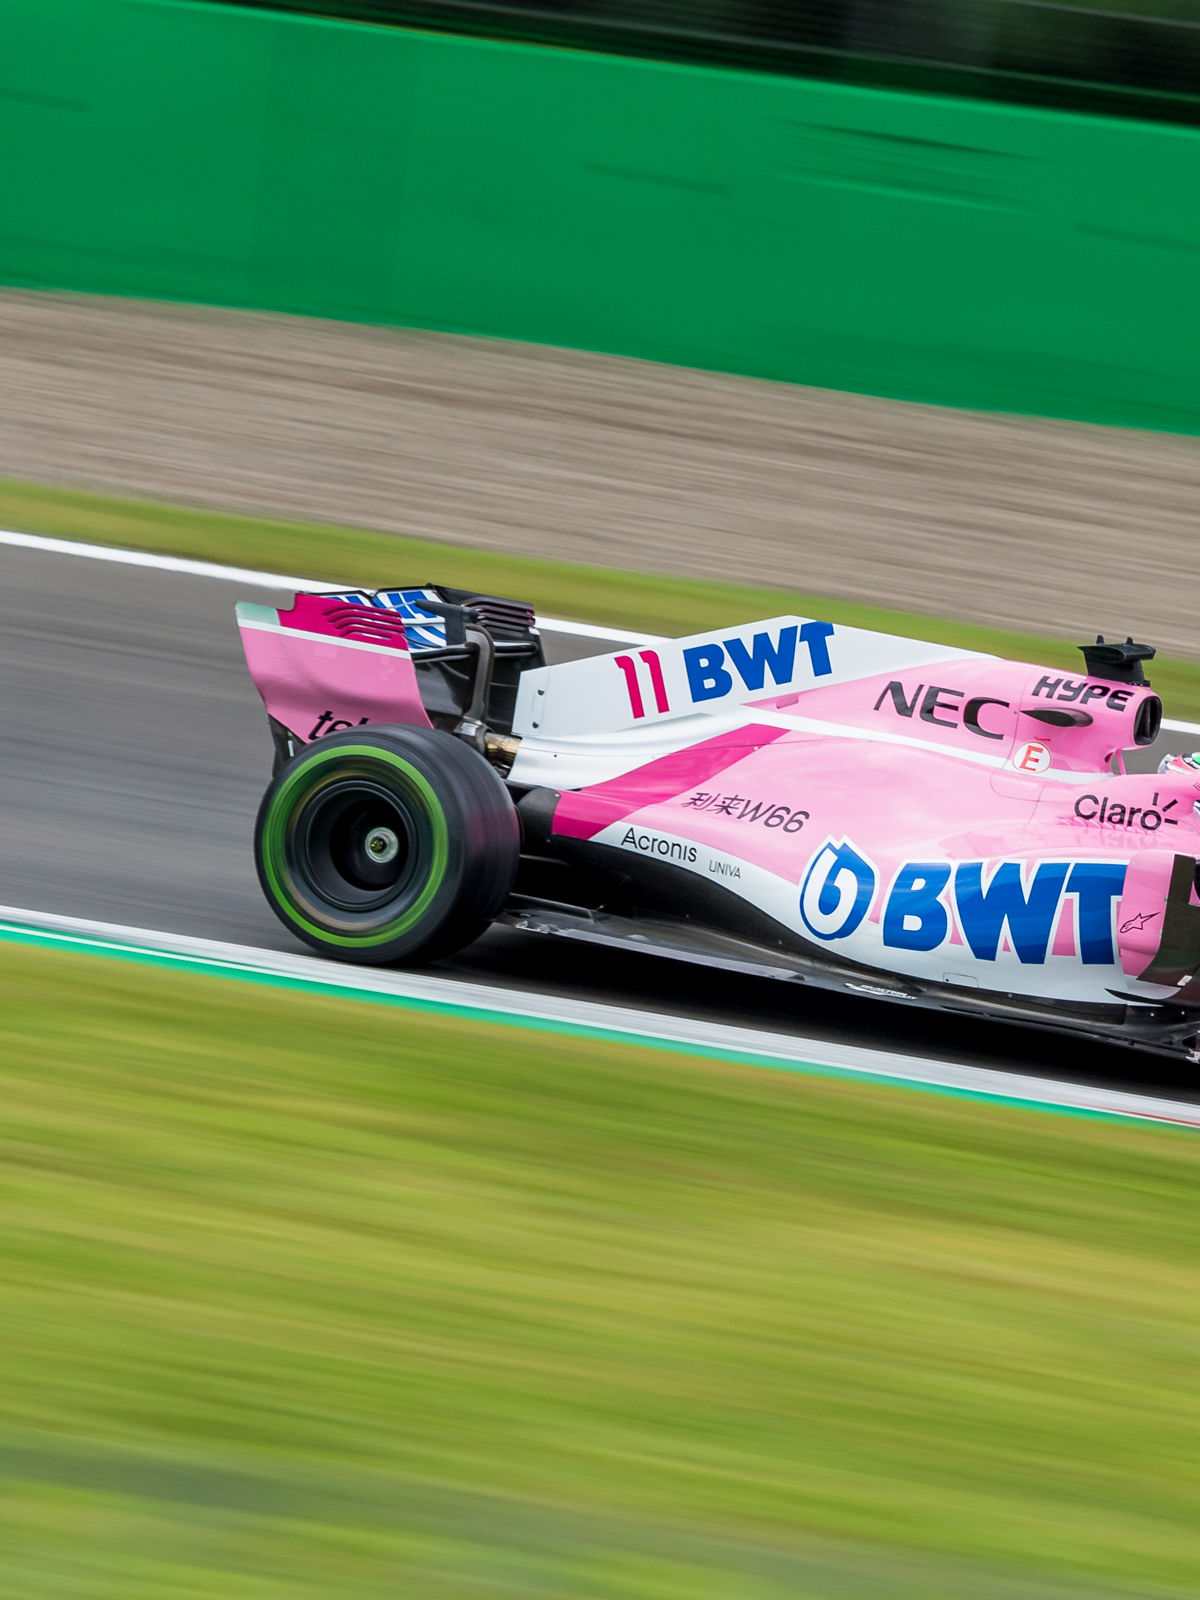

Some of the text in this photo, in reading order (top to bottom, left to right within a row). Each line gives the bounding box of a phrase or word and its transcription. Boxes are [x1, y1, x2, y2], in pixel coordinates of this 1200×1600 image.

[615, 621, 834, 718] 11 BWT
[874, 681, 1010, 741] NEC
[1032, 675, 1135, 712] HYPE
[1020, 746, 1044, 772] E
[1075, 794, 1162, 831] Claro
[620, 827, 697, 863] Acronis
[709, 859, 741, 879] UNIVA
[883, 862, 1125, 964] BWT
